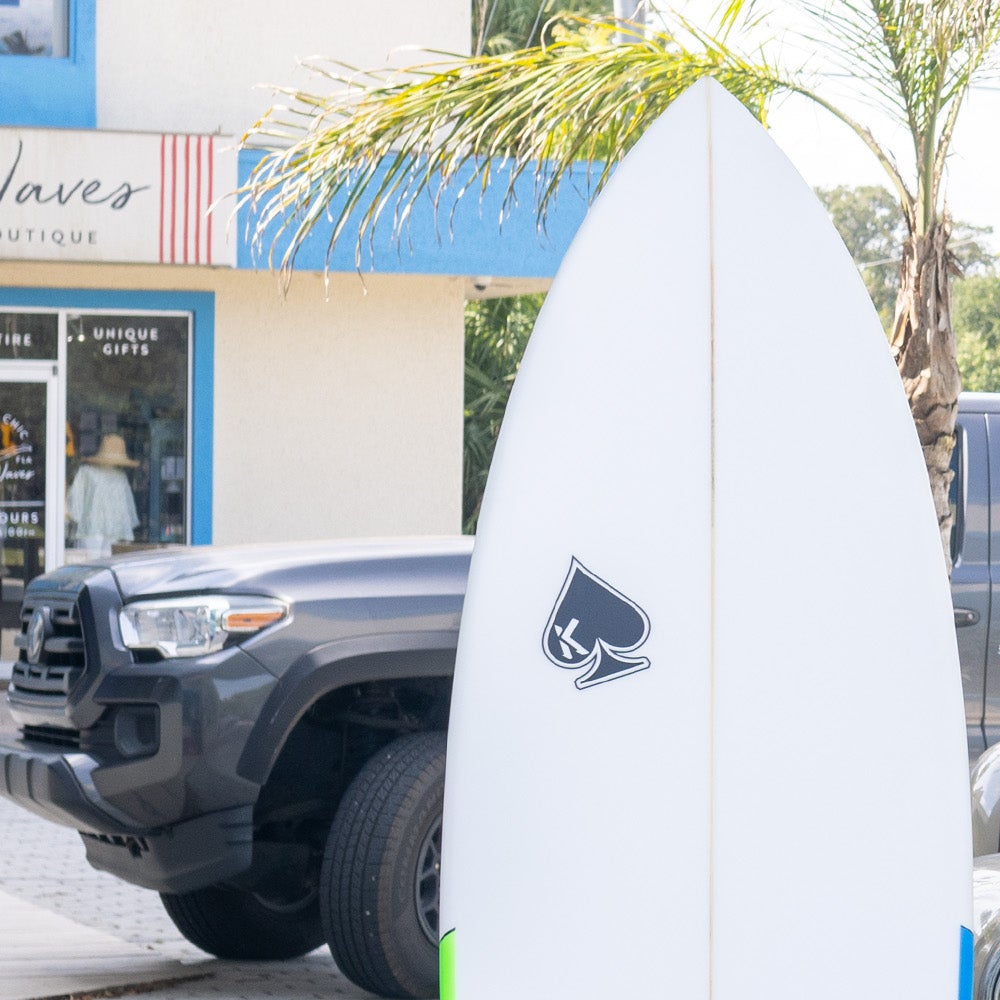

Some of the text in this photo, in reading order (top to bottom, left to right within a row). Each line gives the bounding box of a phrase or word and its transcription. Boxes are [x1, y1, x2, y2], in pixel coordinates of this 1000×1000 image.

[0, 228, 97, 246] UTIQUE
[93, 326, 159, 343] UNIQUE
[102, 342, 149, 357] GIFTS
